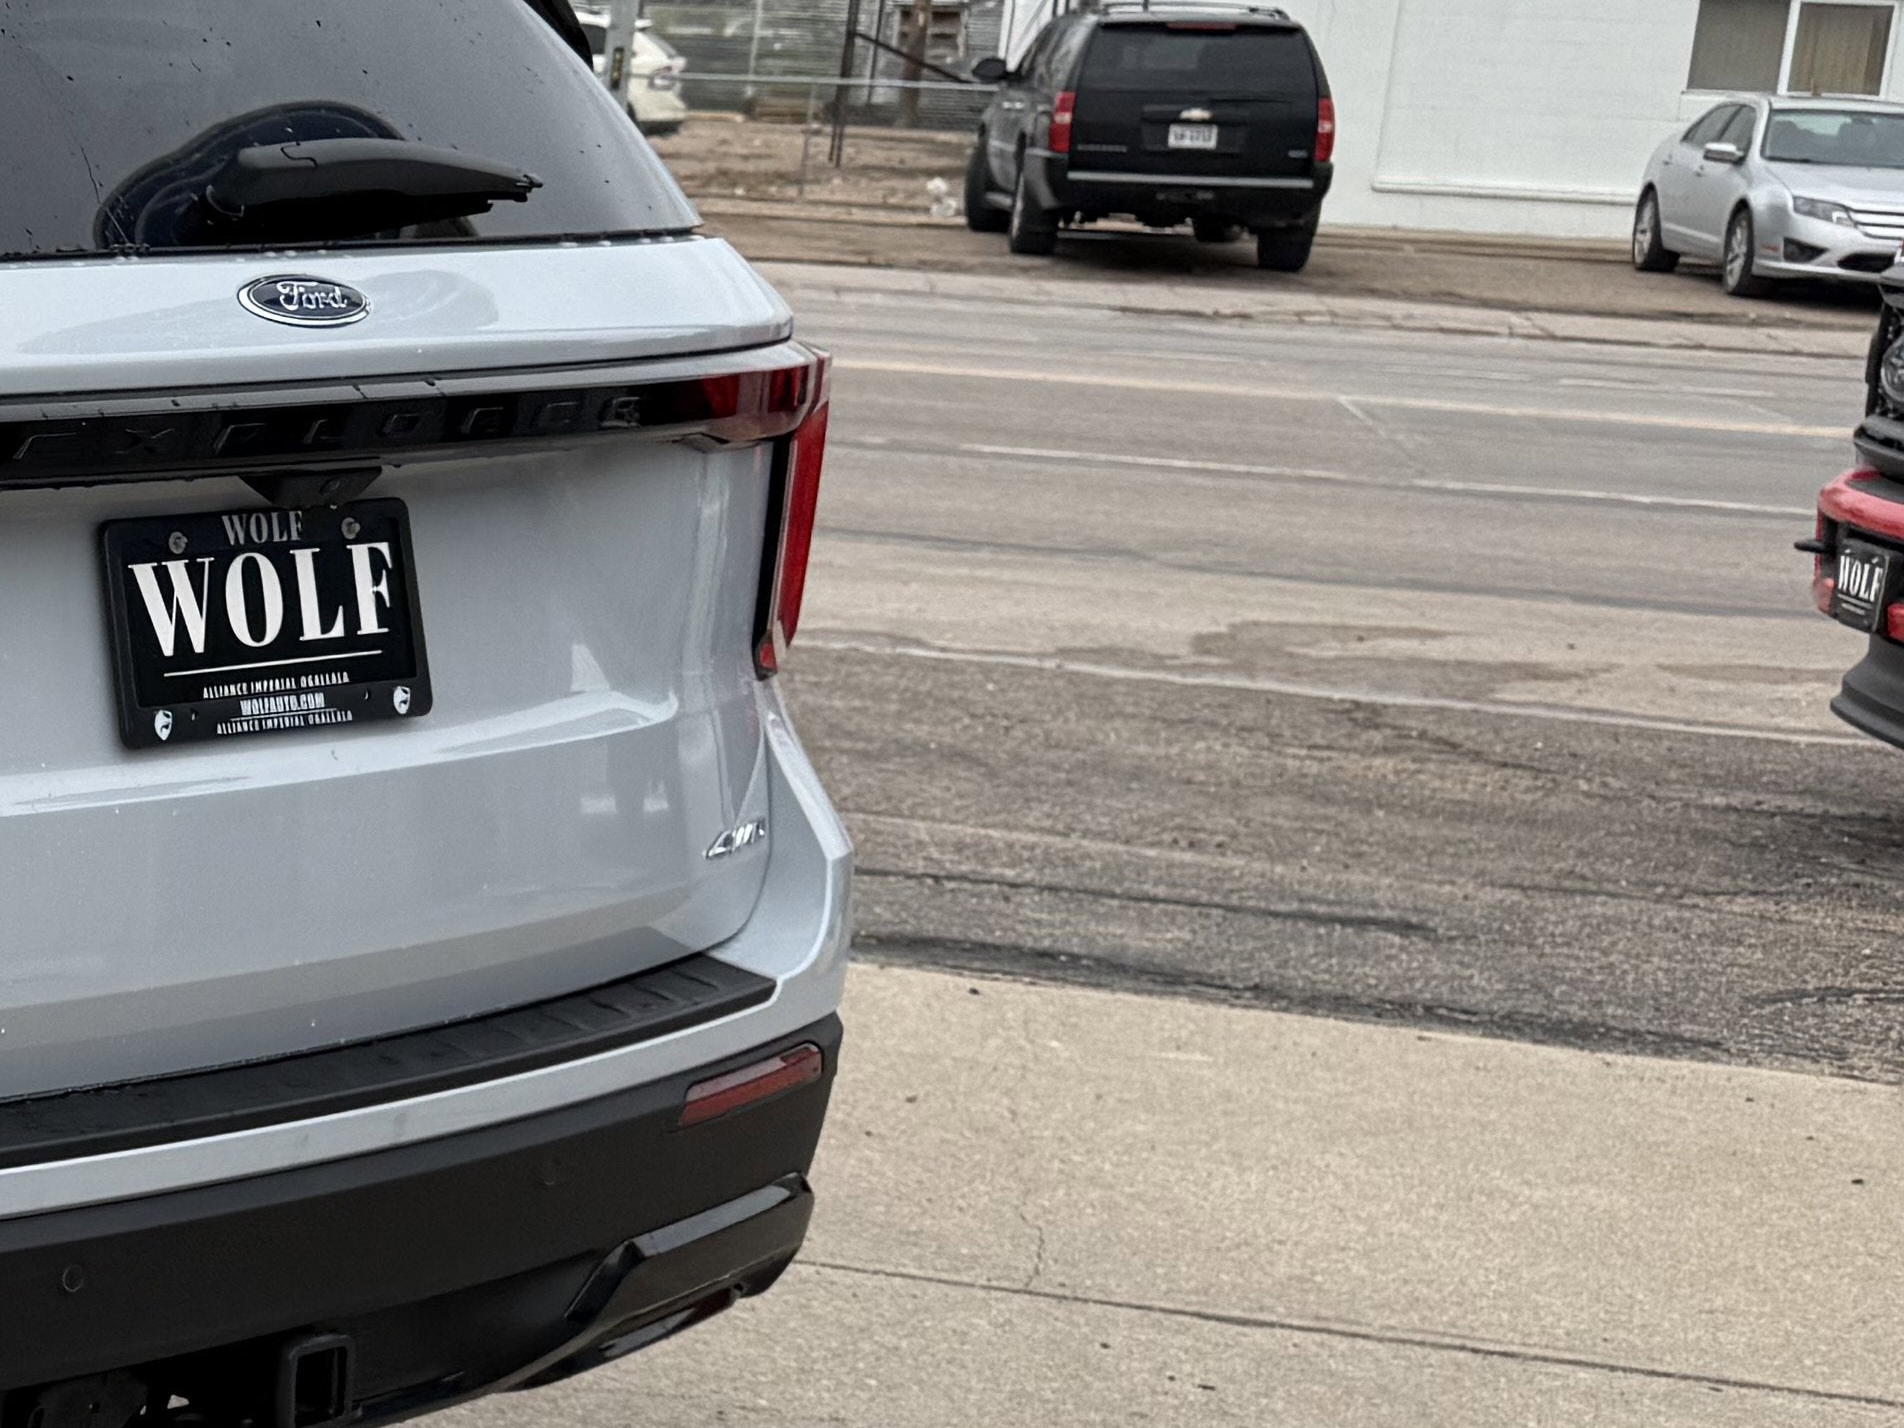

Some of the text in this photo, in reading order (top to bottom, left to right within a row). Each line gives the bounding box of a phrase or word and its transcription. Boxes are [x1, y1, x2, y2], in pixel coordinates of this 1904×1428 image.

[276, 281, 347, 311] Ford
[222, 510, 303, 546] WOLF
[1838, 555, 1884, 602] WOLF
[128, 542, 393, 657] WOLF
[203, 682, 248, 699] ALLIANCE
[239, 692, 326, 716] WOLFAUTO.COM
